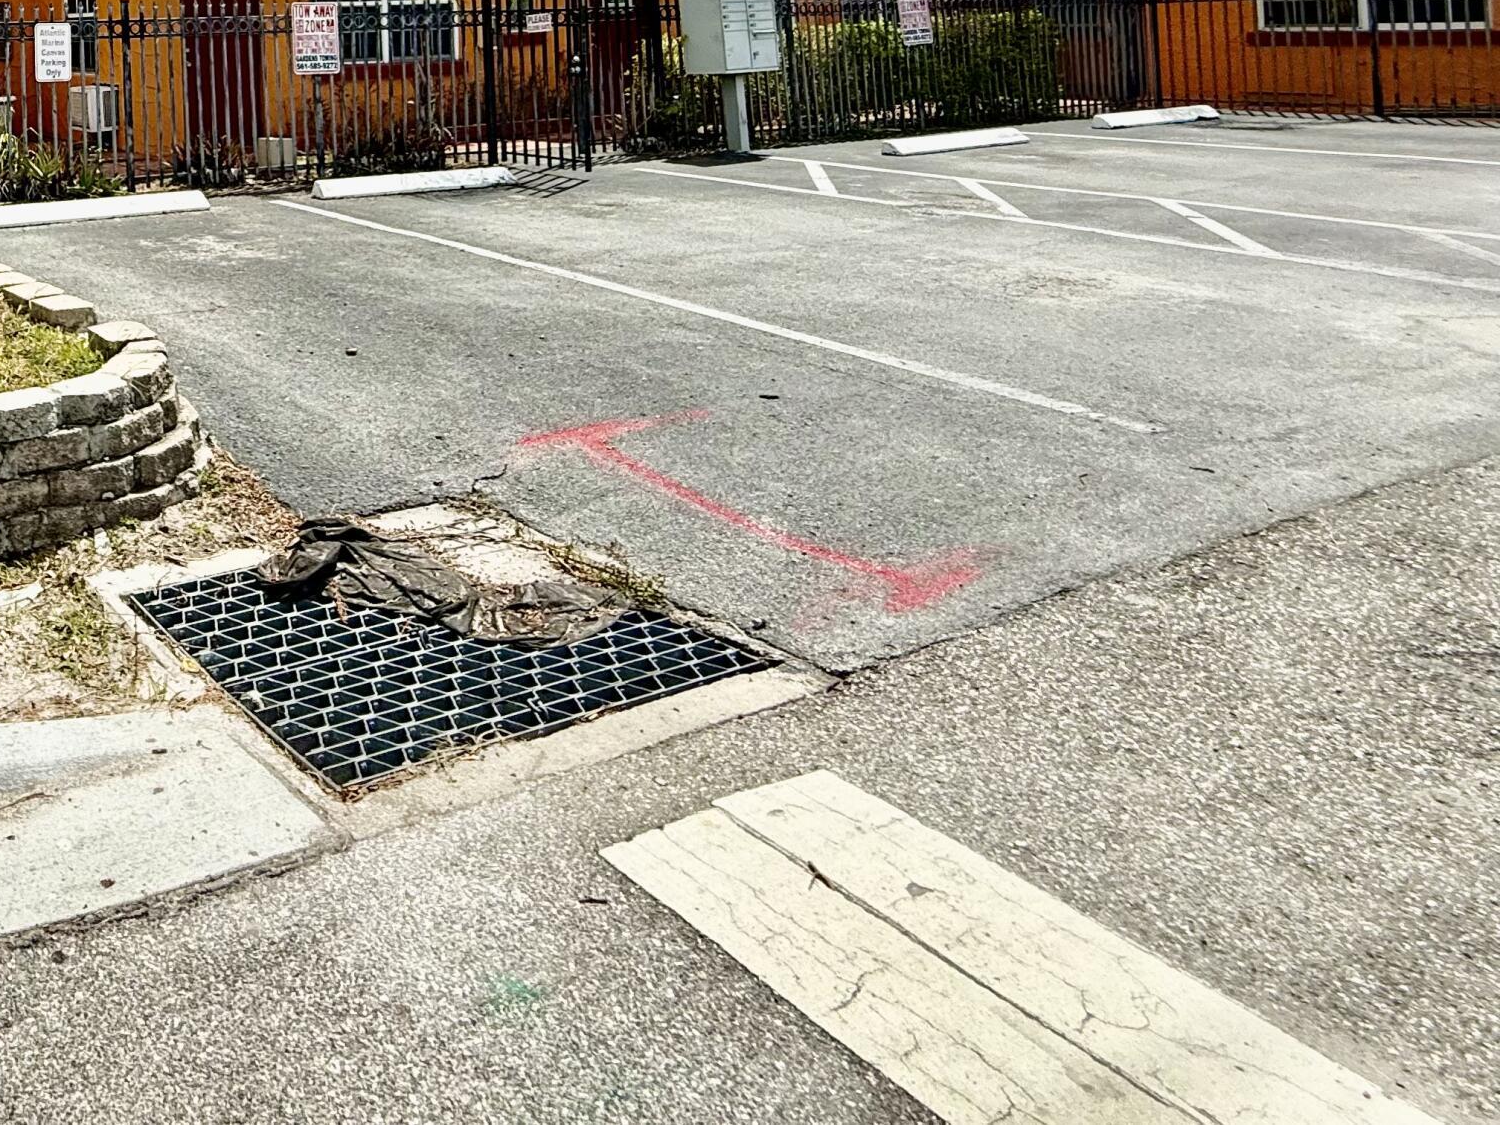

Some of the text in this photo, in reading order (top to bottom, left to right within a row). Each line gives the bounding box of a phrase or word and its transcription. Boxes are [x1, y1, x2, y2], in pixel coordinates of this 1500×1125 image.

[295, 5, 334, 18] TOW AWAY
[528, 14, 550, 24] PLEASE
[305, 20, 326, 33] ZONE
[41, 48, 66, 56] Canvas
[41, 59, 66, 67] Parking
[46, 69, 62, 77] Only
